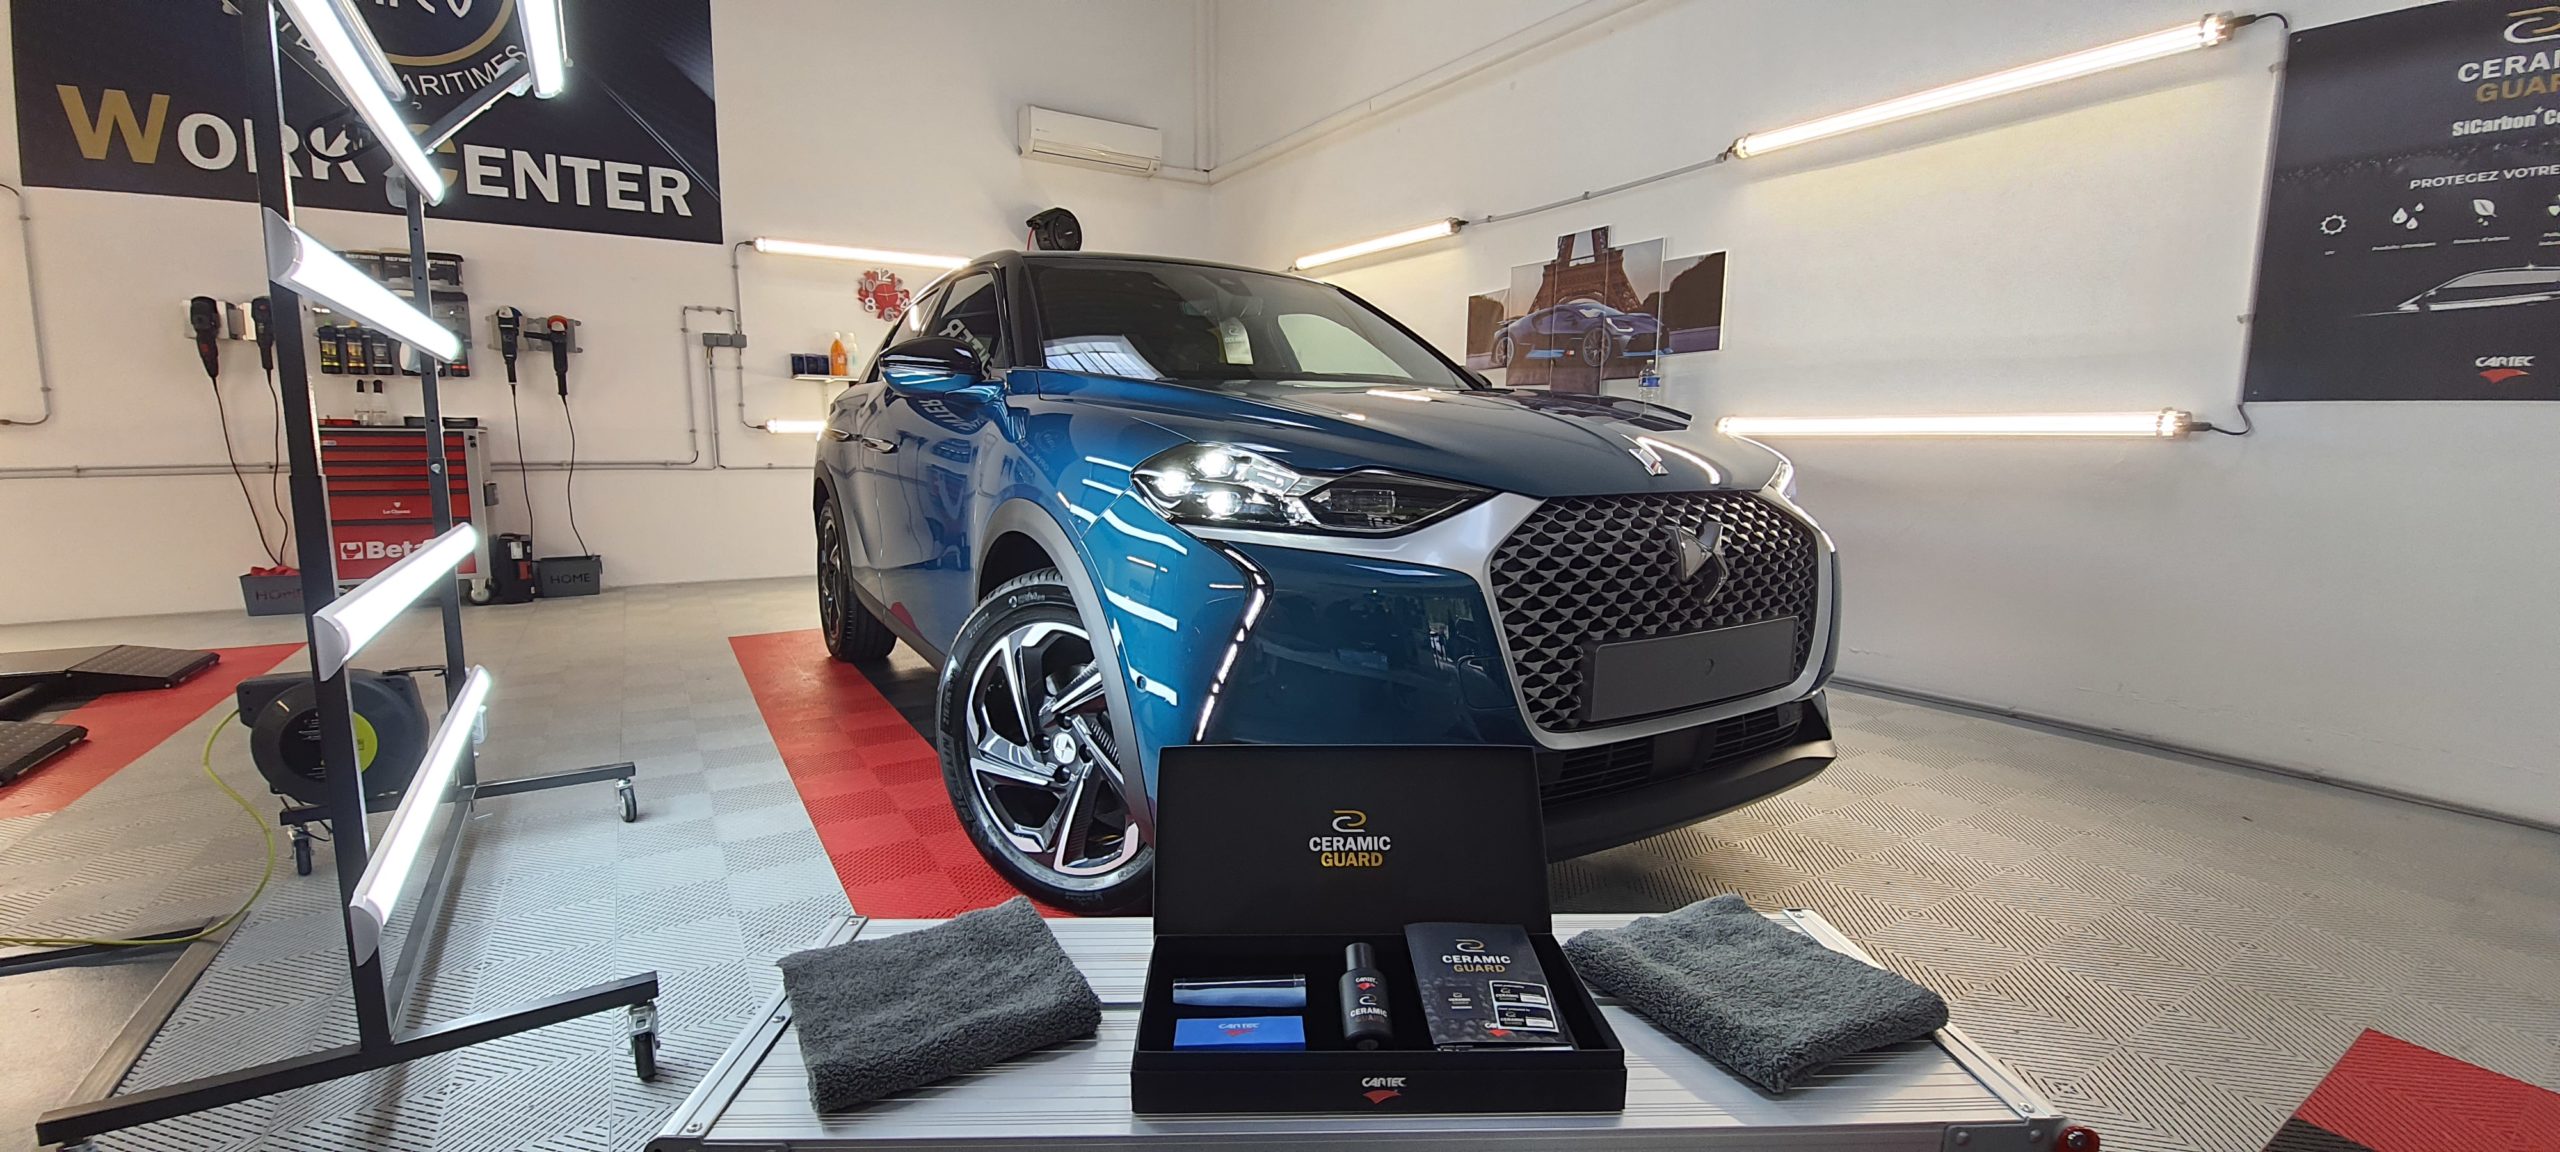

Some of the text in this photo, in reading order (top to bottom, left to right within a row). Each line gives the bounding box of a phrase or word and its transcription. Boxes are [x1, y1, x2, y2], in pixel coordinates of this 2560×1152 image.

[2458, 49, 2560, 82] CERA
[2409, 164, 2560, 190] PROTEGEZ VOTRE
[878, 269, 892, 281] 12
[864, 297, 876, 312] 8
[2475, 355, 2536, 368] CARTEC
[550, 573, 591, 584] HOME
[1309, 836, 1391, 852] CERAMIC
[1321, 852, 1383, 867] GUARD
[1442, 955, 1511, 964] CERAMIC
[1453, 964, 1506, 973] GUARD
[1350, 1007, 1388, 1017] CERAMIC
[1362, 1077, 1407, 1088] CARTEC
